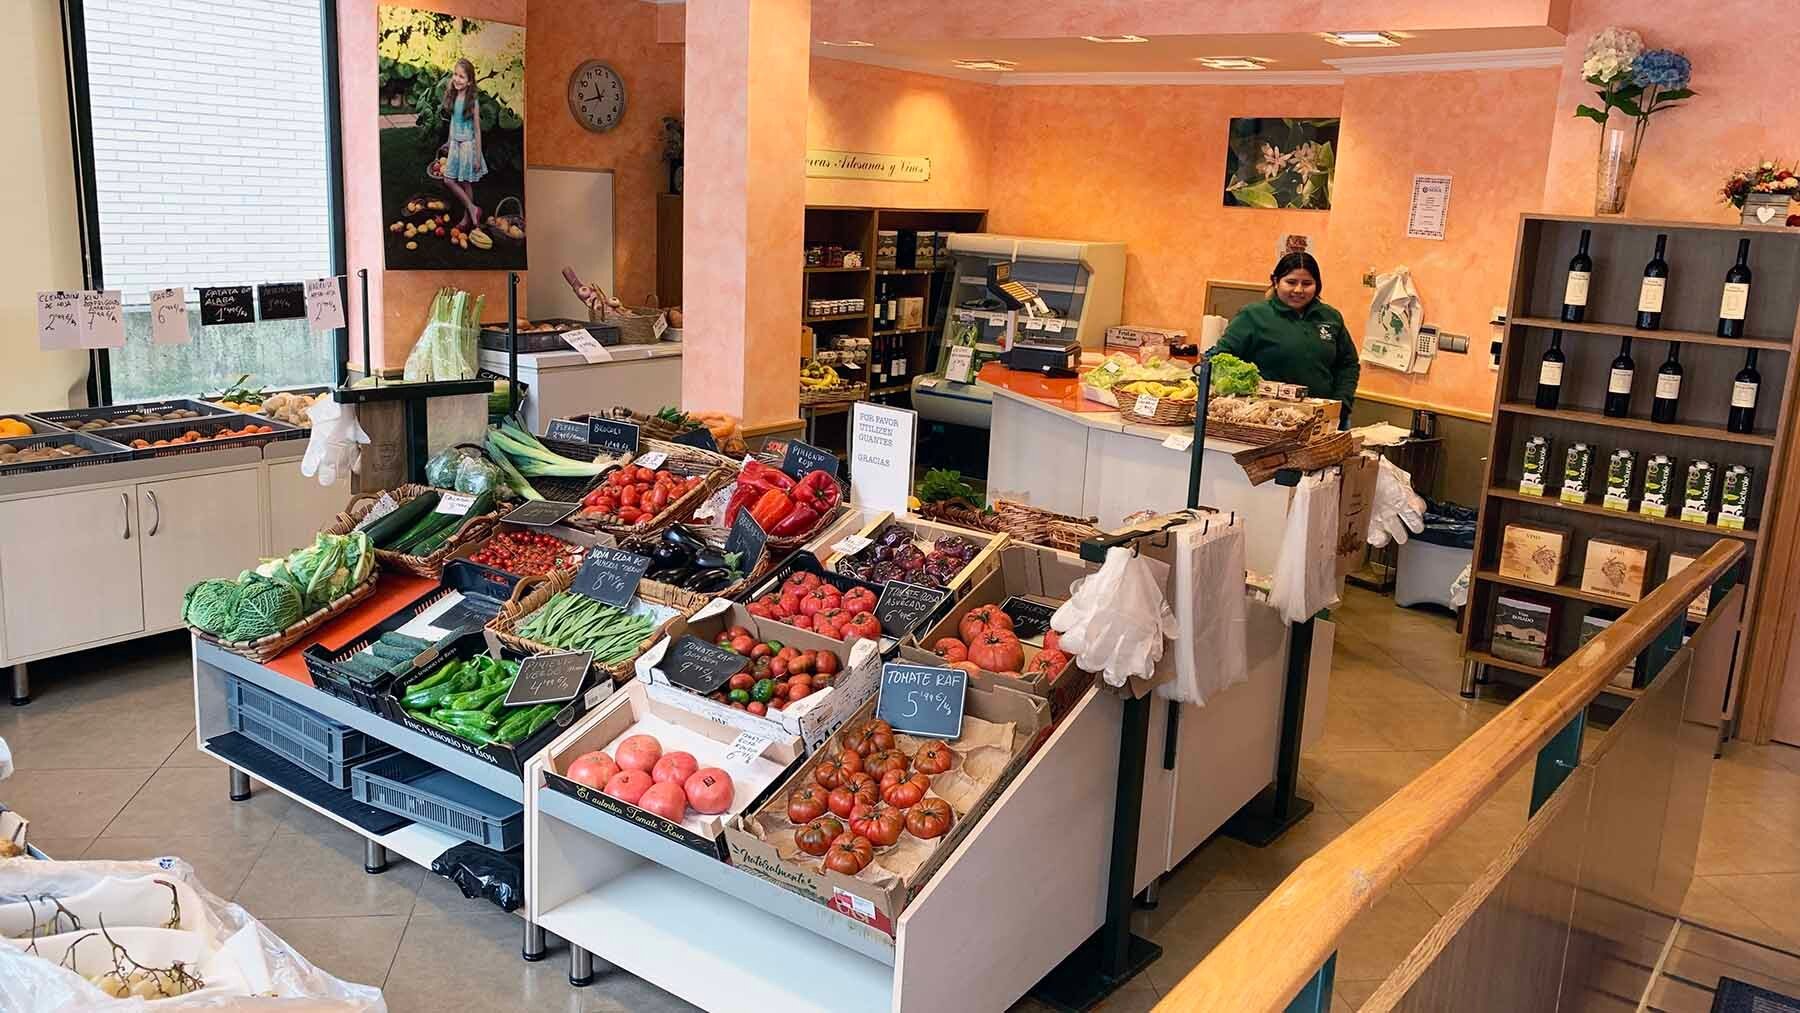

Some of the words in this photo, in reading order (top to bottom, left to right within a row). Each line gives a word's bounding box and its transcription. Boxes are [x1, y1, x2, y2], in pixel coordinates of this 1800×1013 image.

[875, 416, 899, 428] FAVOR
[858, 434, 894, 447] GUANTES
[857, 454, 890, 467] GRACIAS
[683, 641, 718, 657] TOMATE
[887, 670, 933, 686] TOMATE
[935, 674, 962, 687] RAF
[403, 717, 427, 734] FINCA
[461, 743, 475, 754] DE
[474, 746, 499, 764] RIOJA
[576, 785, 590, 800] El
[626, 806, 658, 829] Tomate
[660, 821, 685, 841] Rosa
